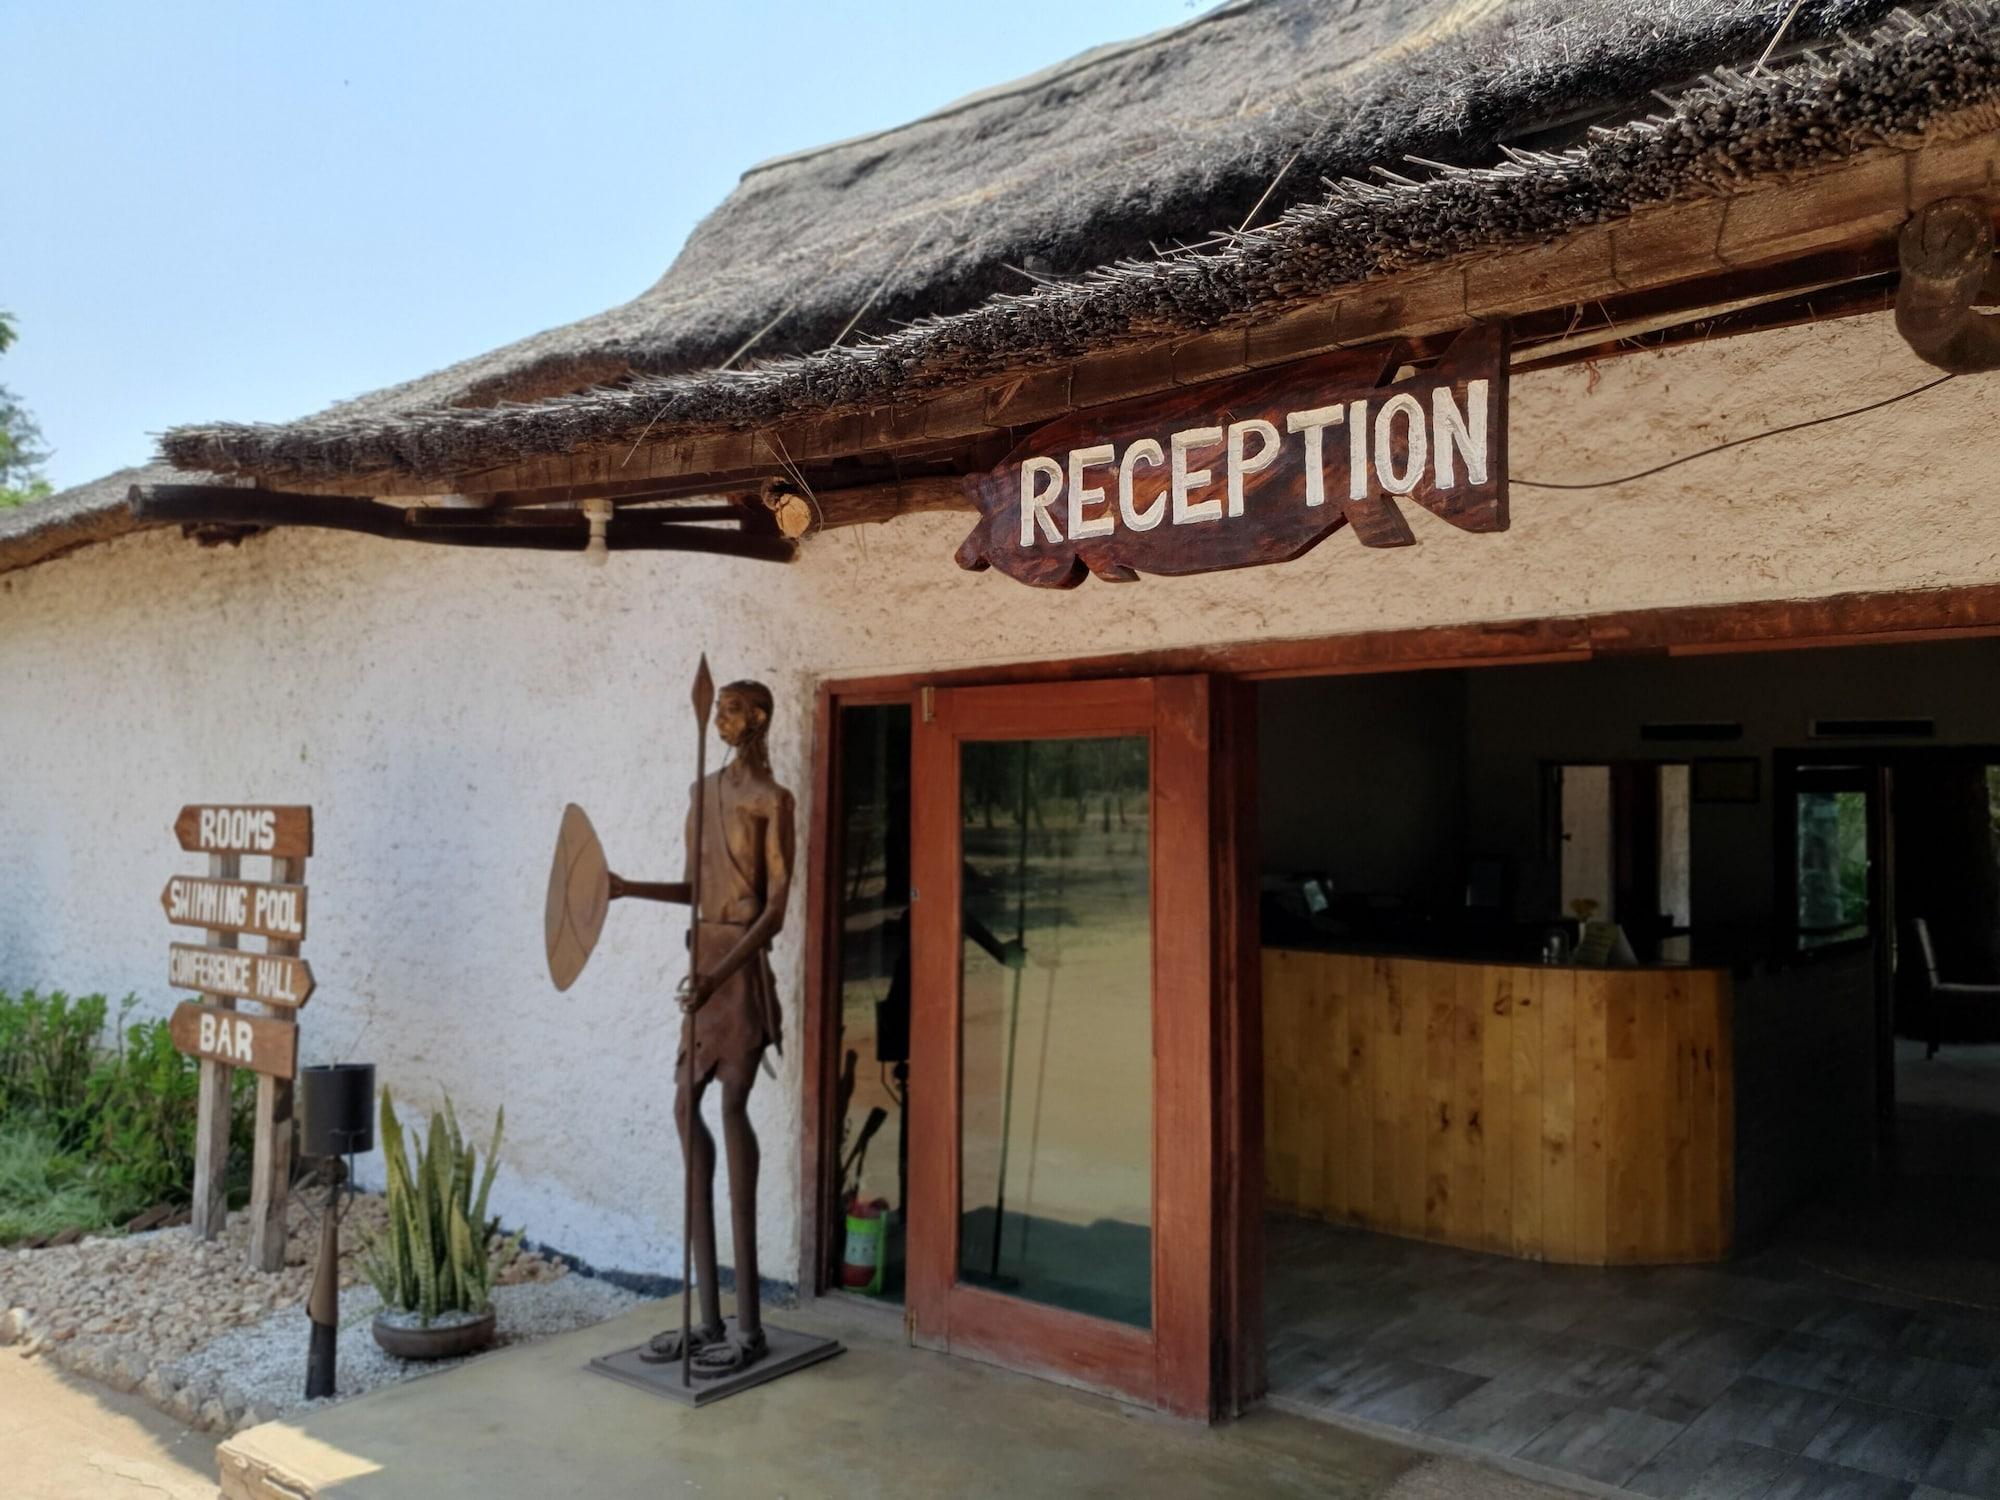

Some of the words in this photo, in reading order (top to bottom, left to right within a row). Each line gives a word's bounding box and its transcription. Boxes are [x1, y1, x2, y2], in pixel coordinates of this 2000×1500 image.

[1019, 379, 1489, 547] RECEPTION
[200, 808, 276, 851] ROOMS
[254, 888, 302, 933] POOL
[256, 955, 297, 1001] HALL
[200, 1012, 254, 1062] BAR
